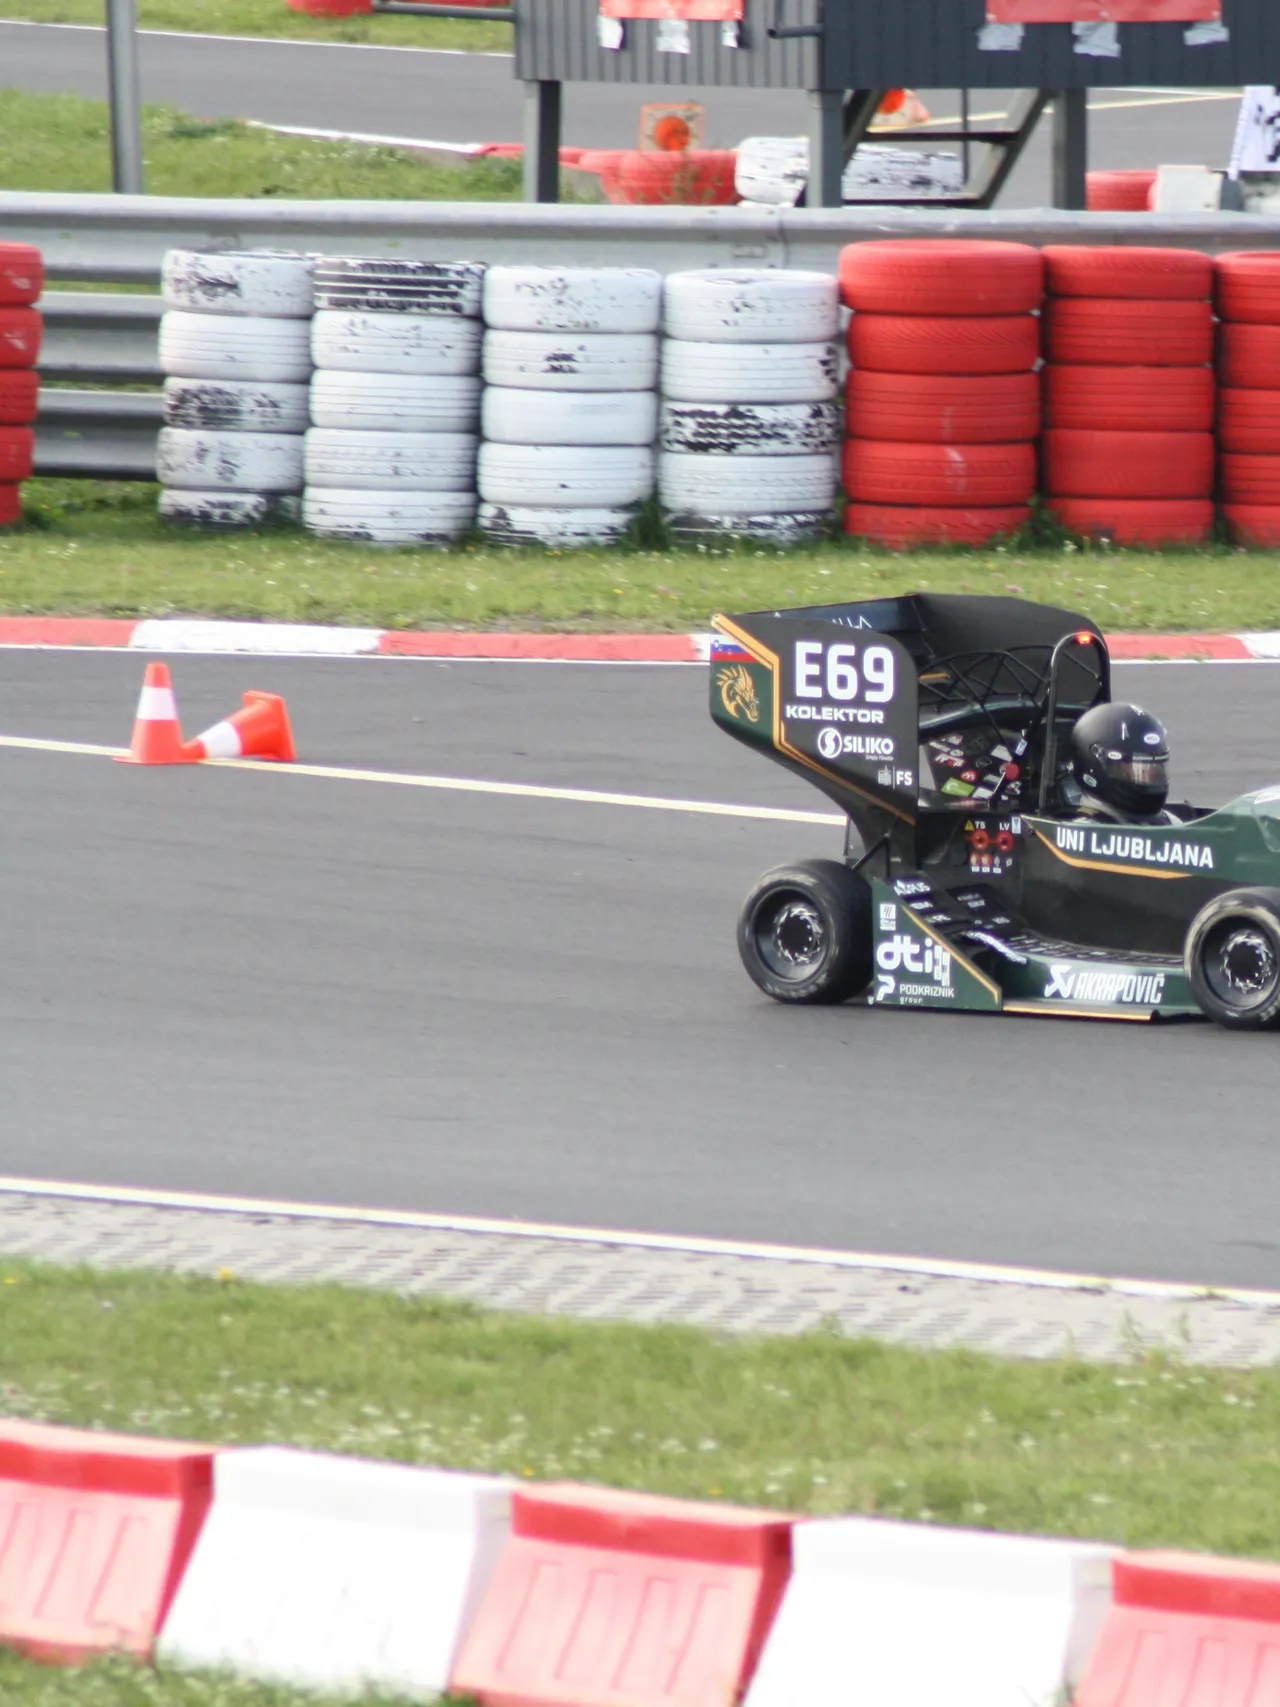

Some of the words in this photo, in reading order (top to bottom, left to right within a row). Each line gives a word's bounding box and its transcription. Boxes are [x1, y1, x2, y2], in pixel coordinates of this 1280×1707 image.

[795, 641, 894, 703] E69
[786, 705, 884, 723] KOLEKTOR
[843, 736, 894, 755] SILIKO
[896, 771, 912, 786] FS
[1000, 822, 1010, 831] LV
[1056, 827, 1084, 852] UNI
[1091, 833, 1214, 869] LJUBLJANA
